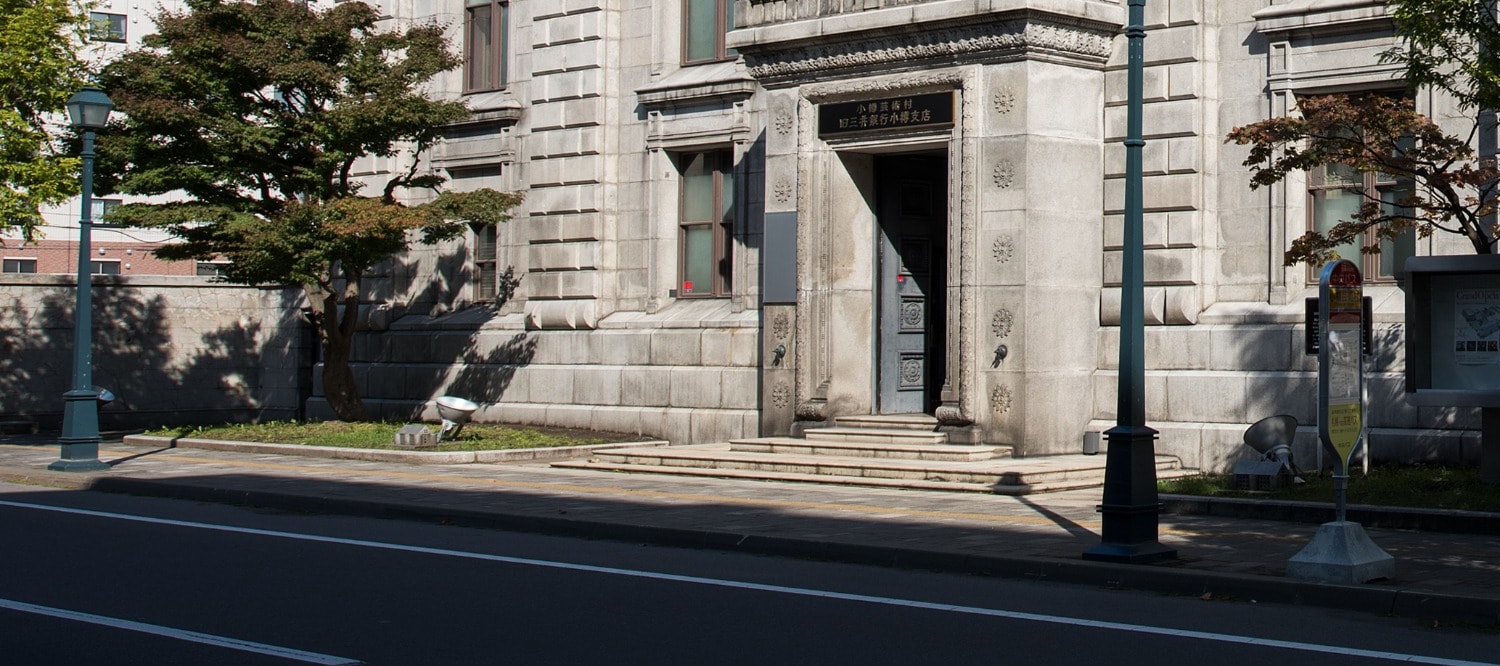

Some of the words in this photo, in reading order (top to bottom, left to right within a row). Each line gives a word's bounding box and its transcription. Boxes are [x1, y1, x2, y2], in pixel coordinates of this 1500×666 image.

[839, 108, 931, 129] 旧三井銀行小樽支店
